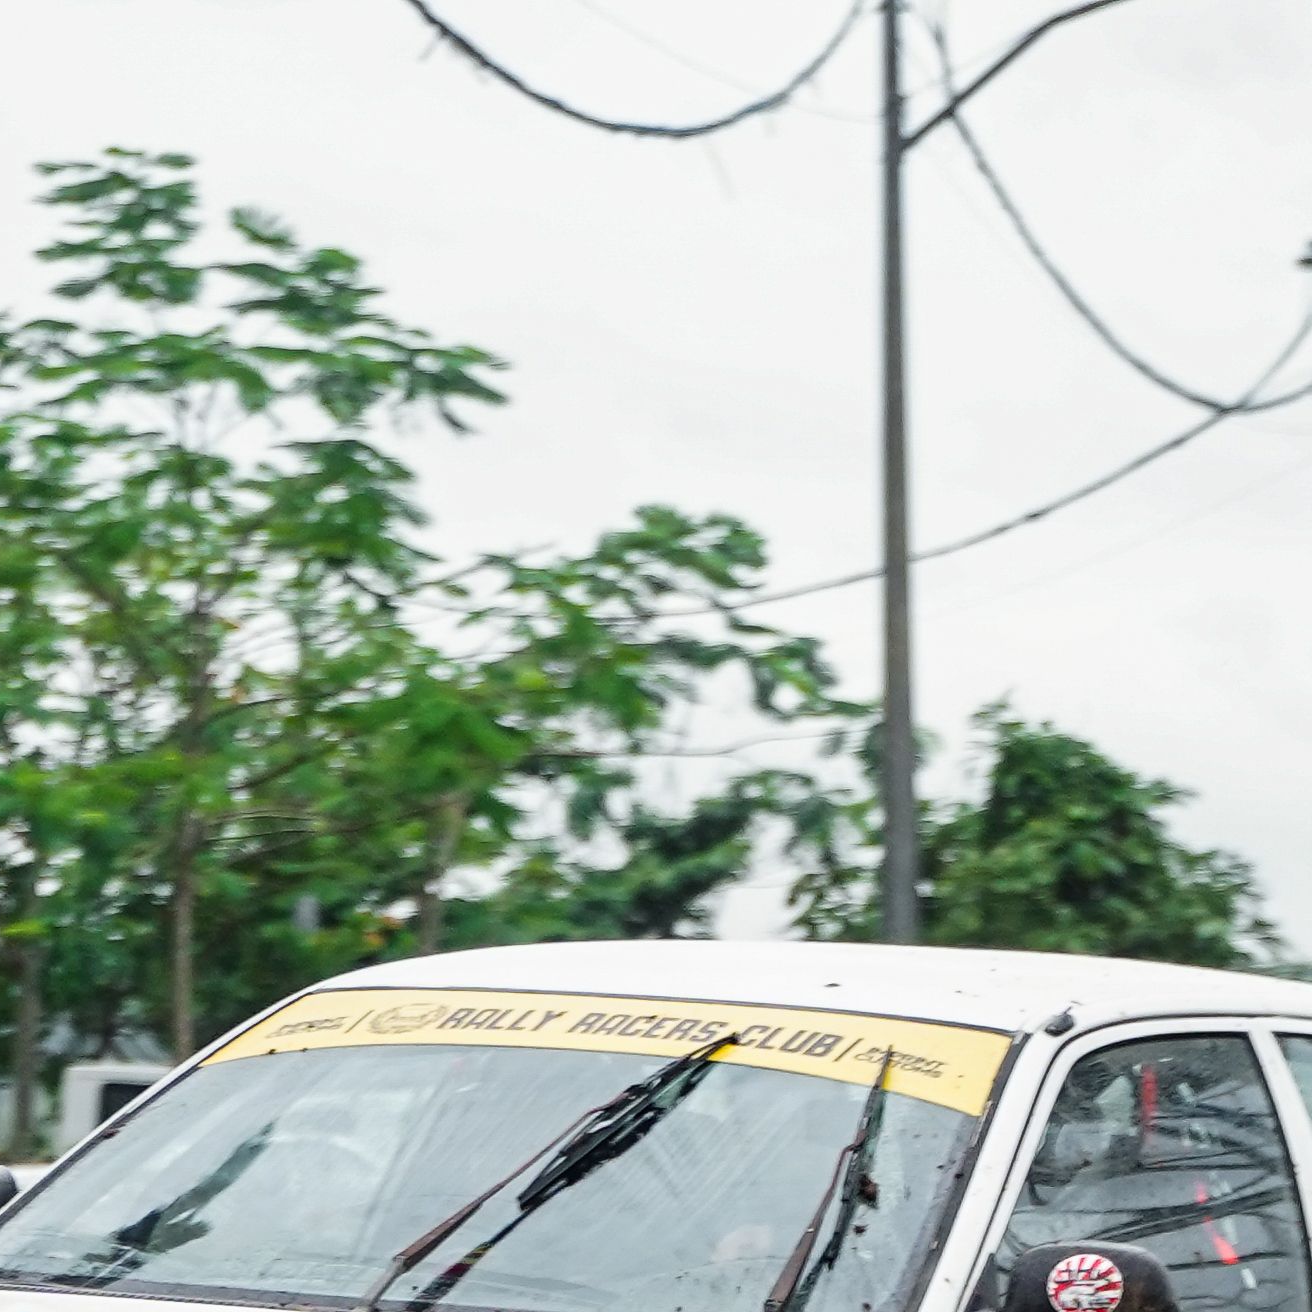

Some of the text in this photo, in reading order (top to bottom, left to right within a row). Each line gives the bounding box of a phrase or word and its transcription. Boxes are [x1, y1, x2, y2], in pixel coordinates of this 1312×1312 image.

[438, 1007, 844, 1057] RALLY RACERS CLUB
